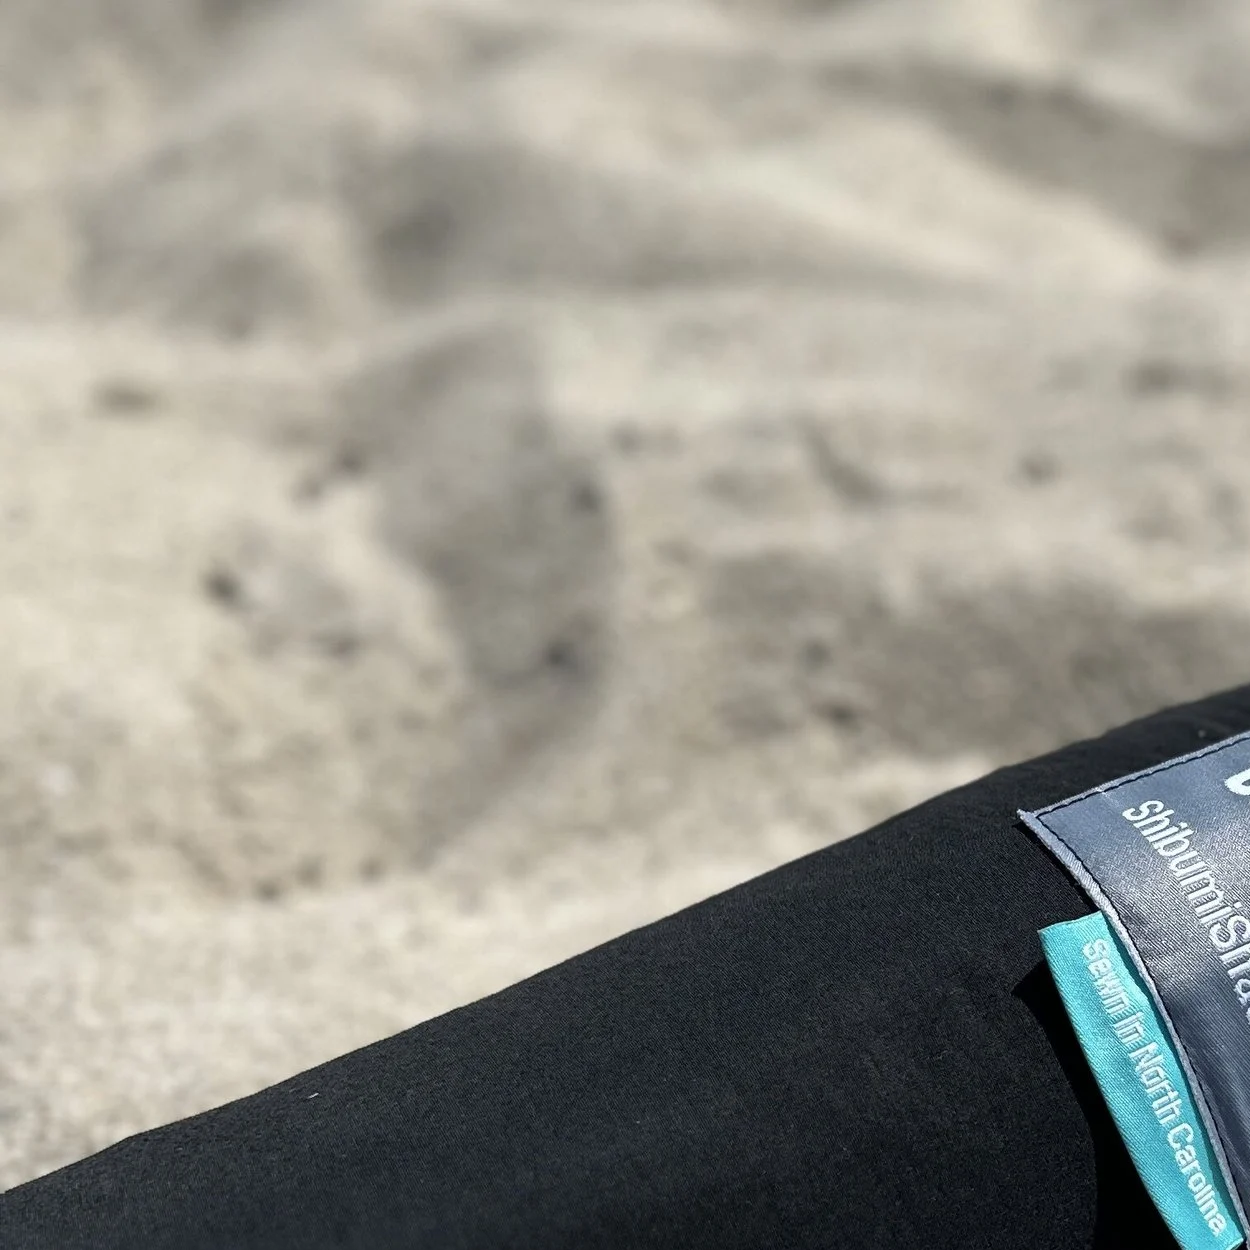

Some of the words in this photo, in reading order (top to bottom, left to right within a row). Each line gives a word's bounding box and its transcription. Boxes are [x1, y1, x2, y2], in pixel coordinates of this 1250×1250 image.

[1082, 937, 1129, 1016] Sewn
[1128, 1042, 1183, 1126] North
[1167, 1121, 1228, 1237] Carolina
